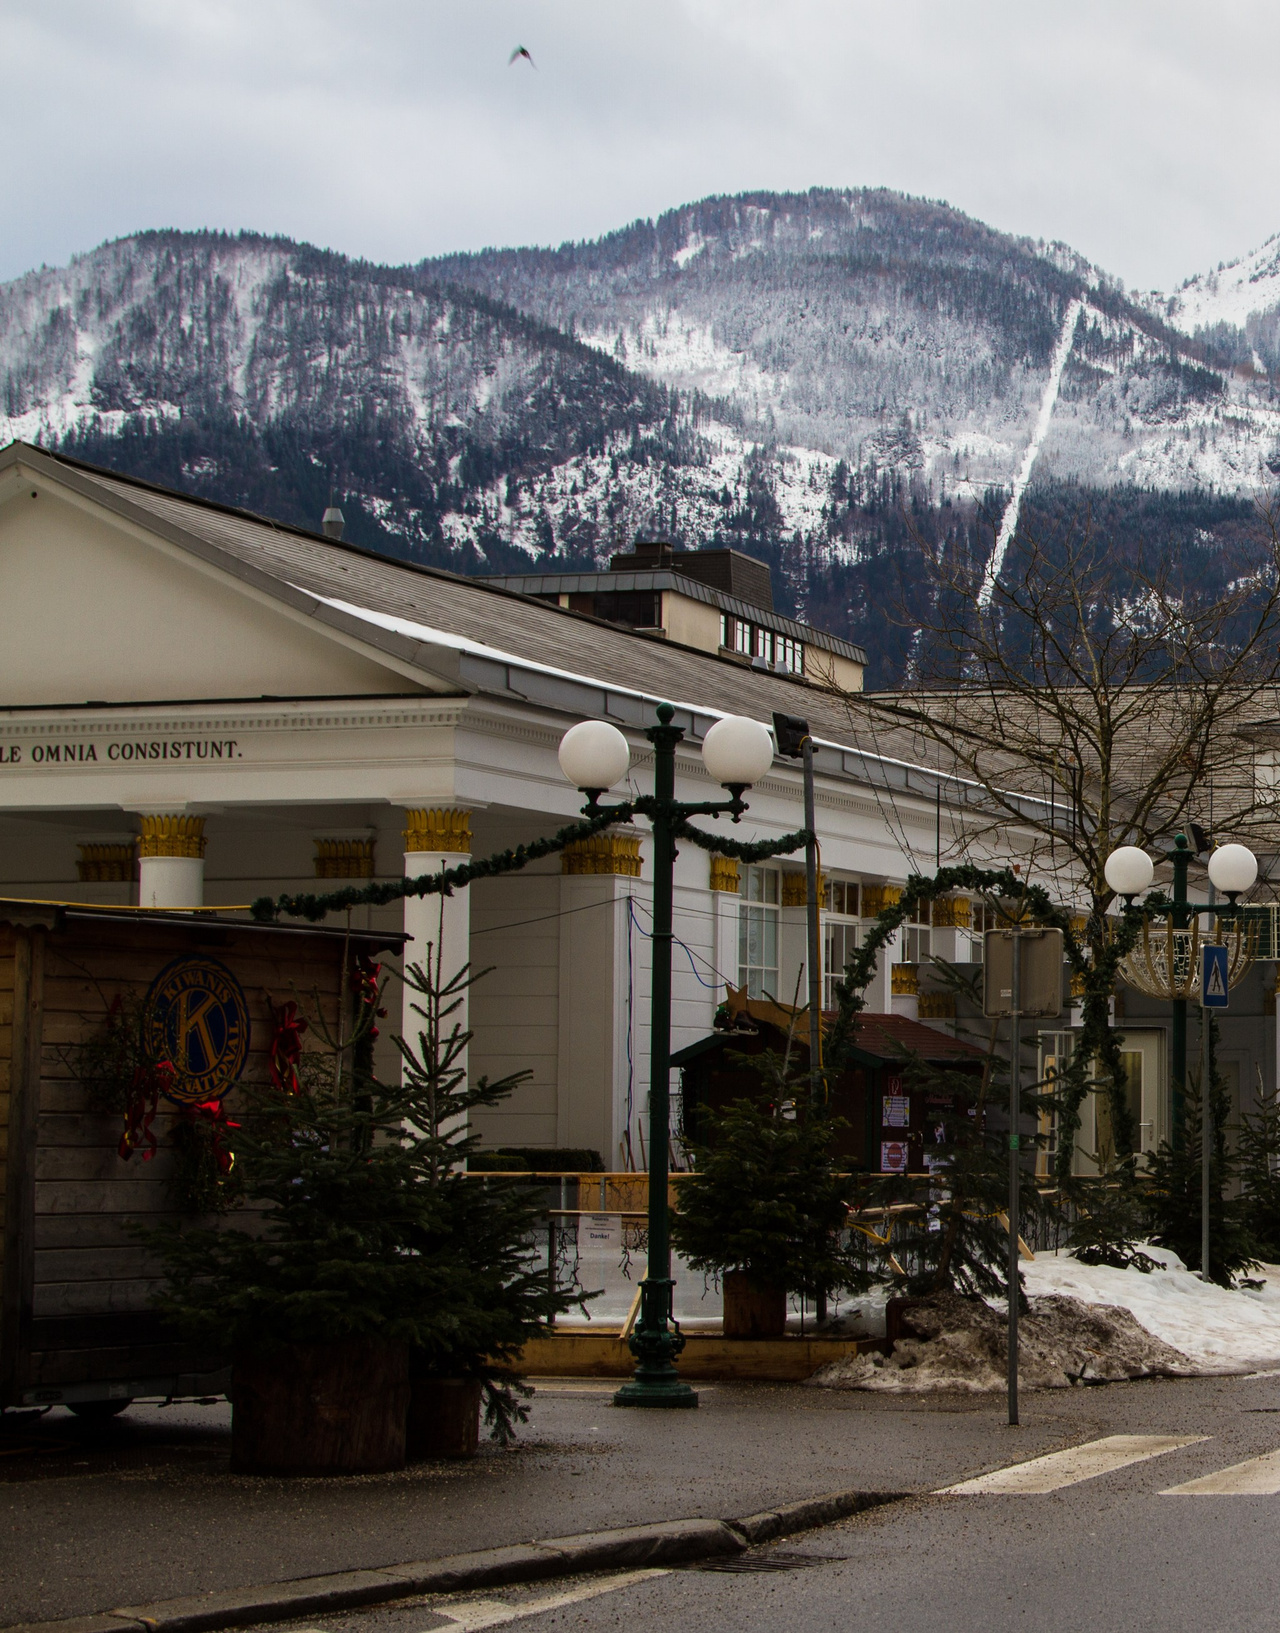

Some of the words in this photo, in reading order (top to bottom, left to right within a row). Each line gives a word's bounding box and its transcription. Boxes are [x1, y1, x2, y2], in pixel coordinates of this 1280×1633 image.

[31, 744, 98, 763] OMNIA
[107, 741, 243, 760] CONSISTUNT.
[163, 970, 232, 1004] KIWANIS
[152, 1020, 239, 1093] INNATIONAL
[176, 989, 223, 1072] K
